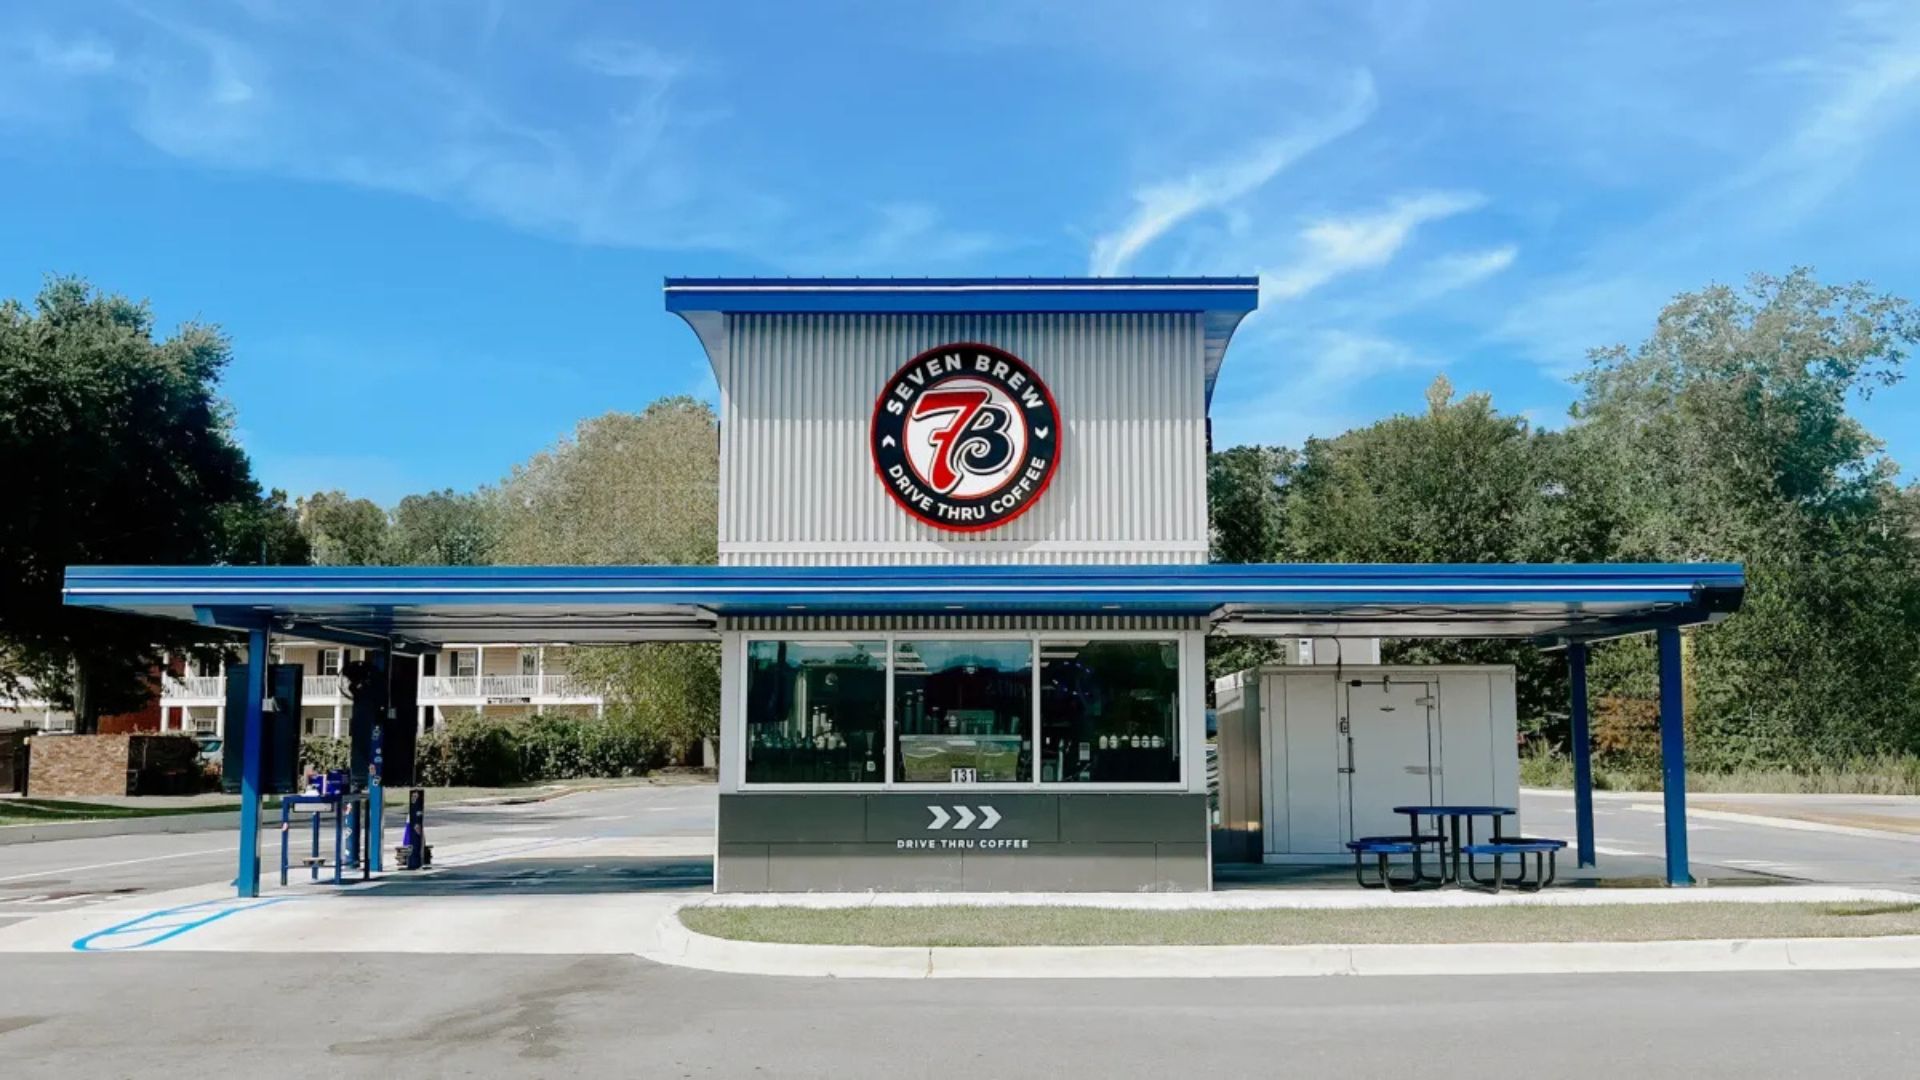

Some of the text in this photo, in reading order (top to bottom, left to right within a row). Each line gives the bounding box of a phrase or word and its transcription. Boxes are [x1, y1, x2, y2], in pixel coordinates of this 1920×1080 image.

[887, 353, 1044, 415] SEVEN BREW
[912, 386, 1014, 494] 7B
[889, 456, 1046, 521] DRIVE THRU COFFEE
[953, 768, 975, 783] 131
[897, 839, 1030, 849] DRIVE THRU COFFEE
